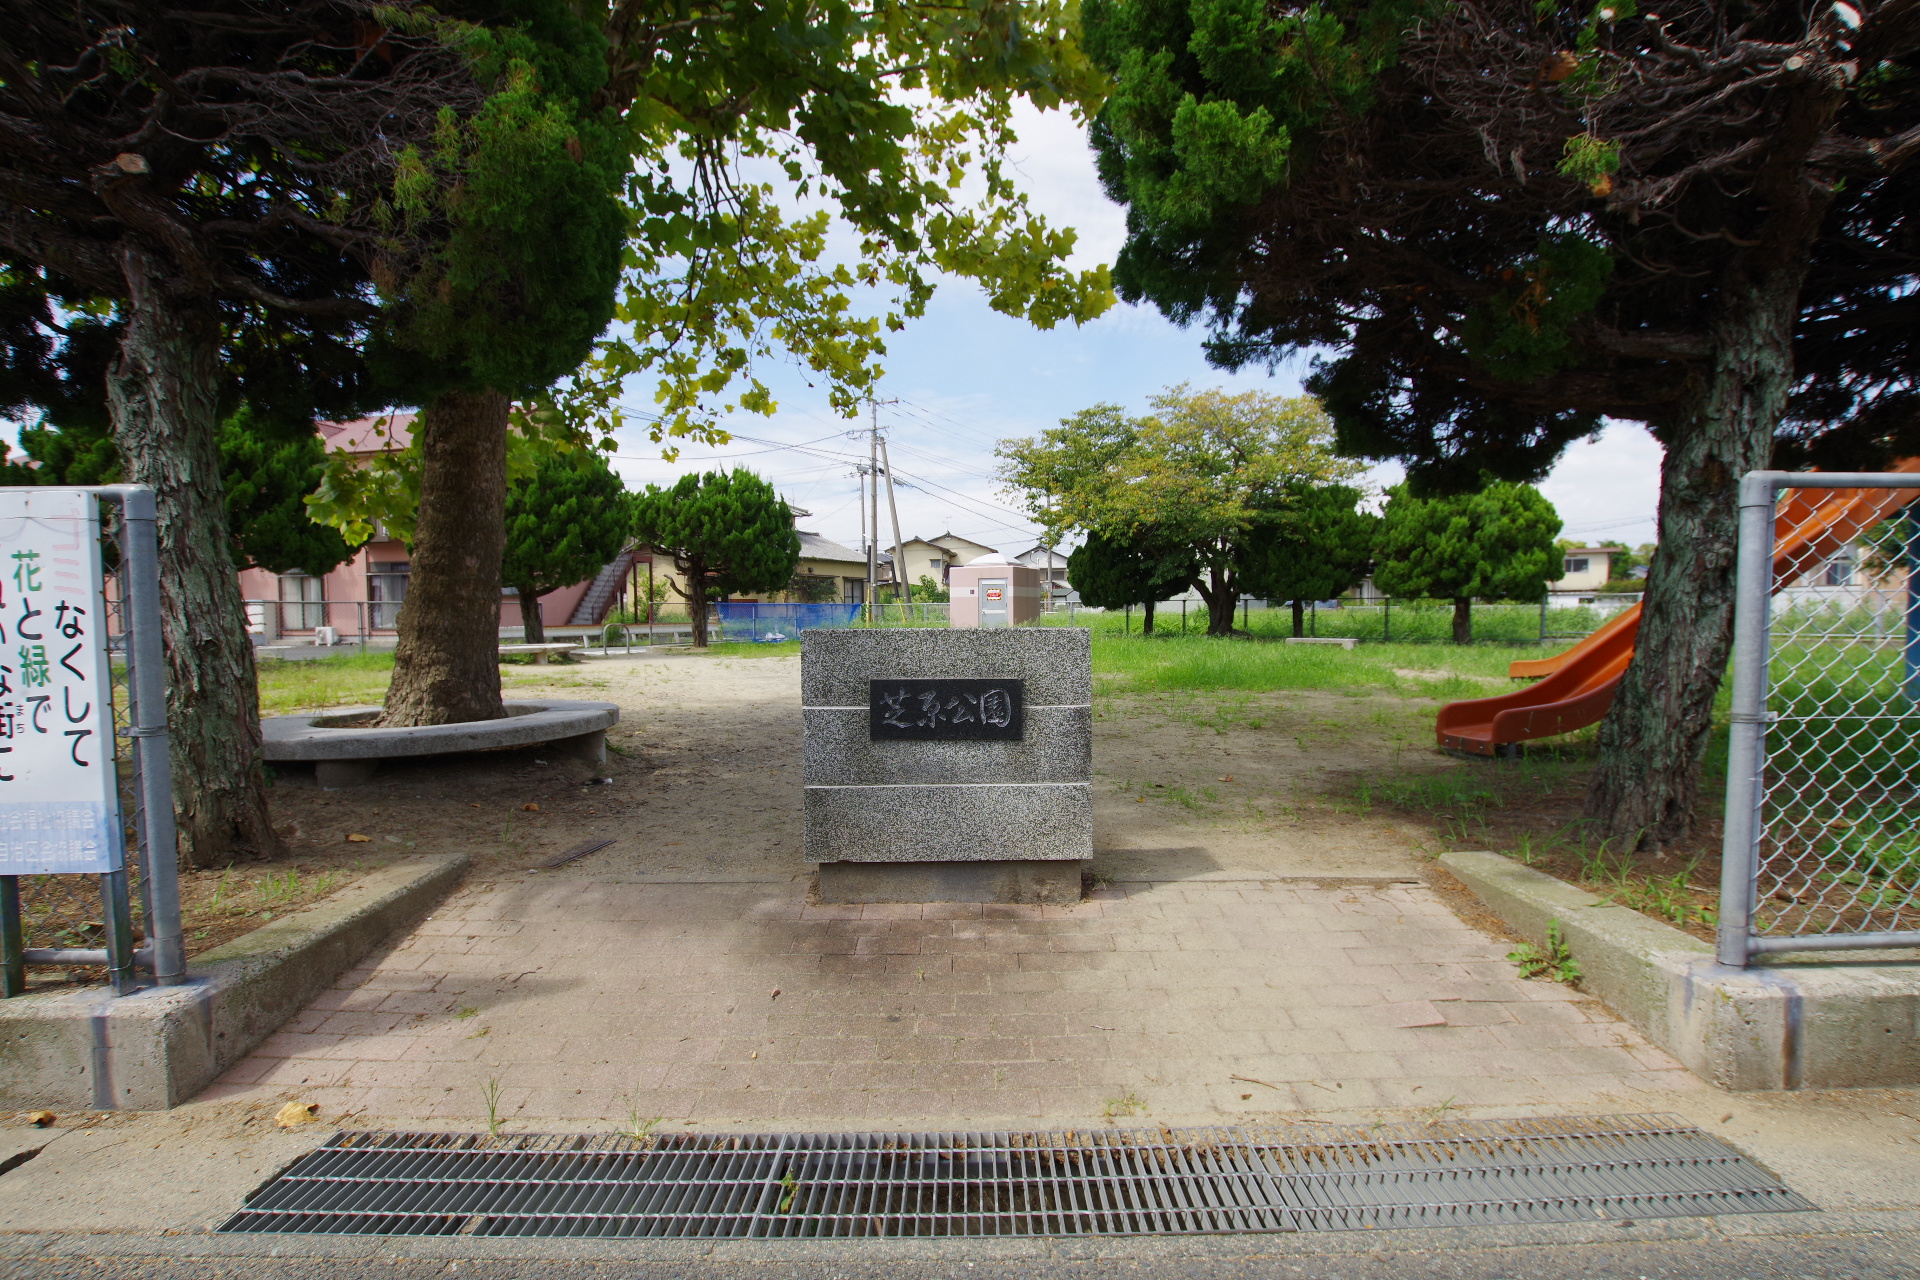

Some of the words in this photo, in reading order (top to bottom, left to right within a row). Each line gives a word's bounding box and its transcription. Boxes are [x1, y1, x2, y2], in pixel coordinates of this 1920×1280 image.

[10, 548, 52, 734] 花と緑で
[16, 704, 25, 734] まち
